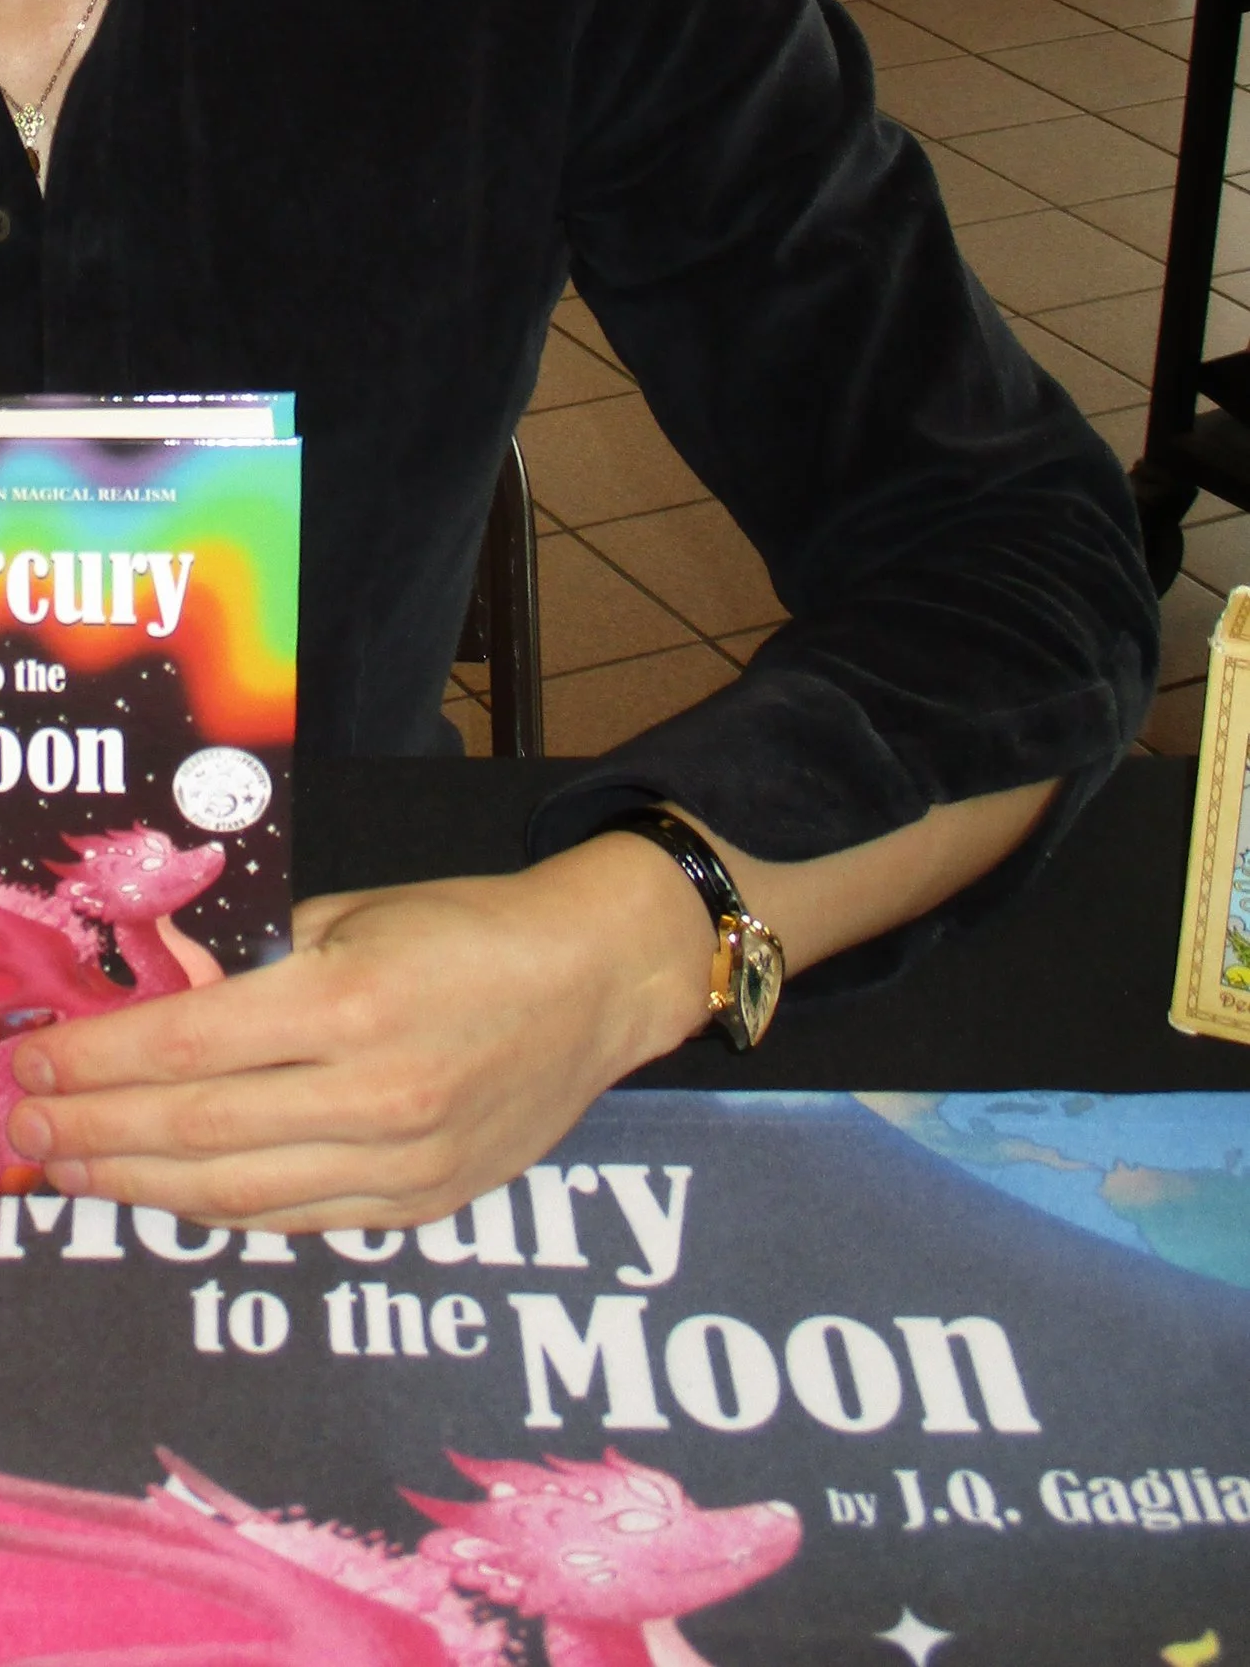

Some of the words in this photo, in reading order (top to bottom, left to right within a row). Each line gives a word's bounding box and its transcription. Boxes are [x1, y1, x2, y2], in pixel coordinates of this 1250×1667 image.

[11, 486, 94, 502] MAGICAL
[98, 486, 177, 503] REALISM
[14, 659, 66, 692] the
[192, 1280, 290, 1354] to
[323, 1282, 488, 1357] the
[506, 1293, 1042, 1433] Moon
[827, 1488, 877, 1528] by
[892, 1469, 1022, 1531] J.Q.
[1039, 1468, 1250, 1531] Gaglia
